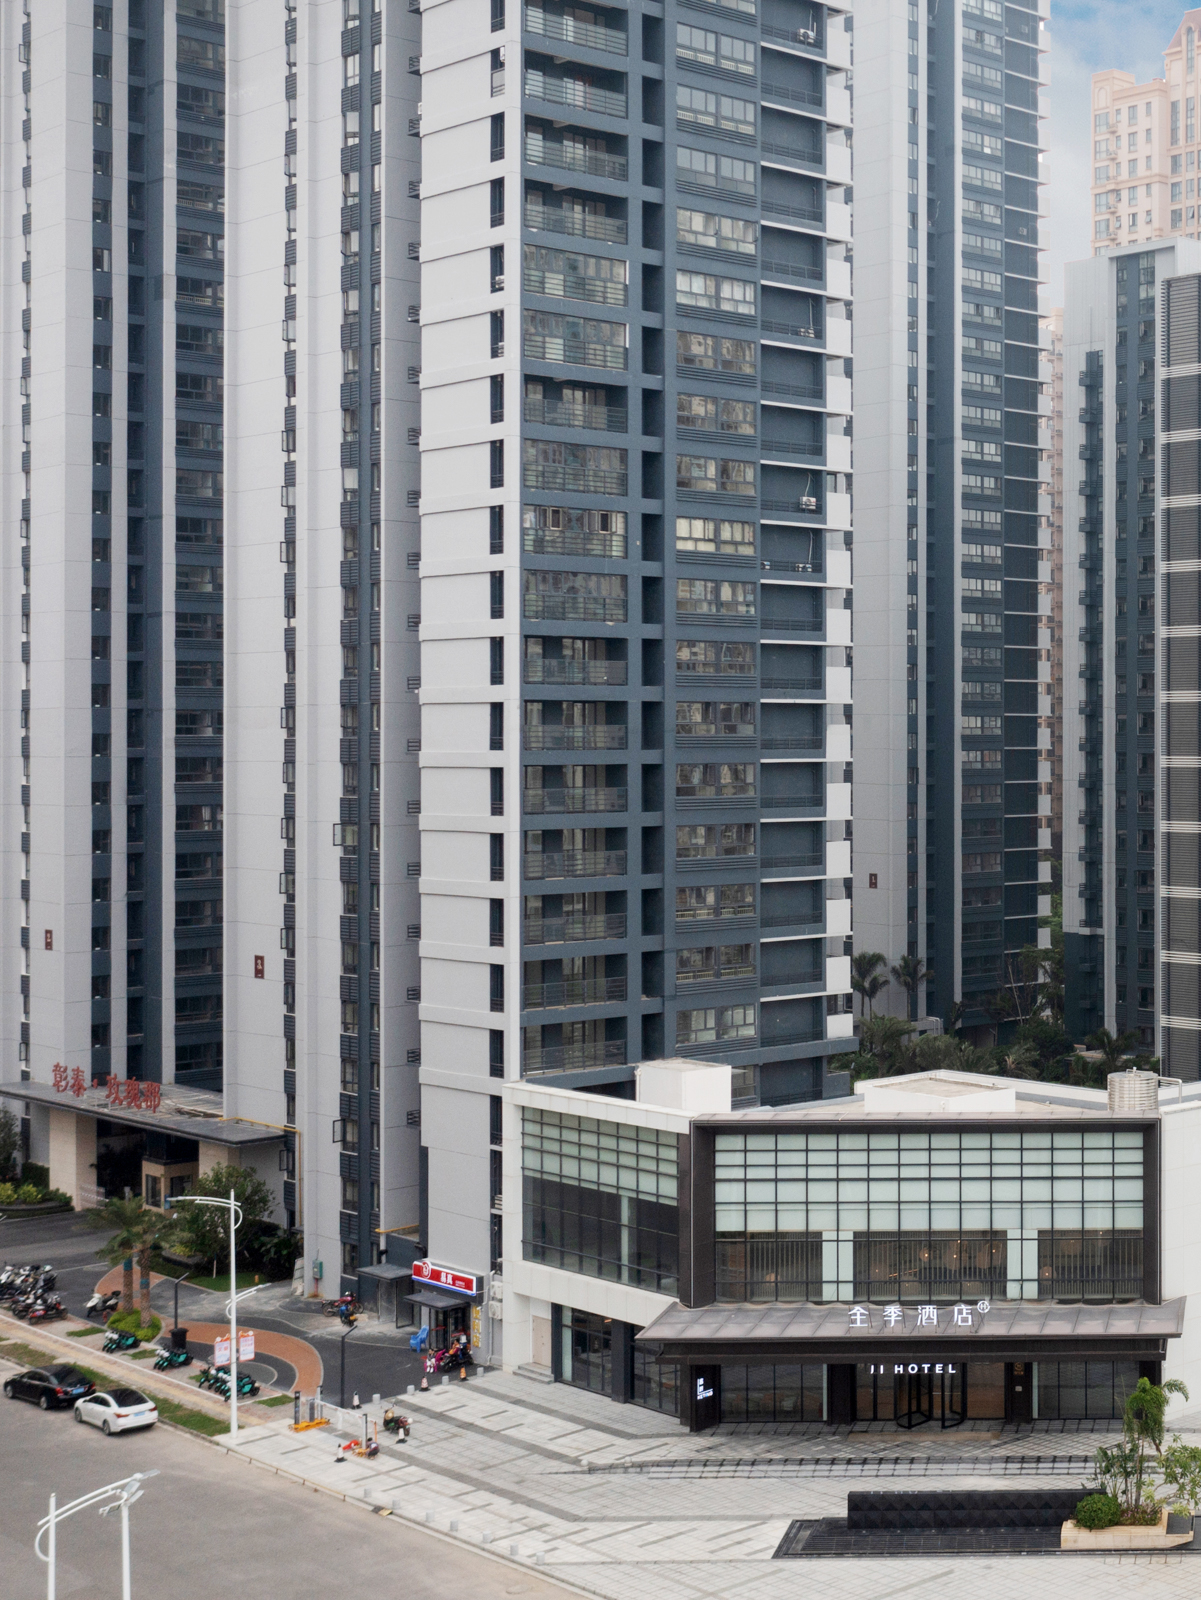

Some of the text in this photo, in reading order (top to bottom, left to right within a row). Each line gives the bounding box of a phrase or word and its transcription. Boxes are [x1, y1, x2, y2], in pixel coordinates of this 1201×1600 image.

[848, 1304, 973, 1328] 全季酒店
[870, 1363, 957, 1375] JI HOTEL
